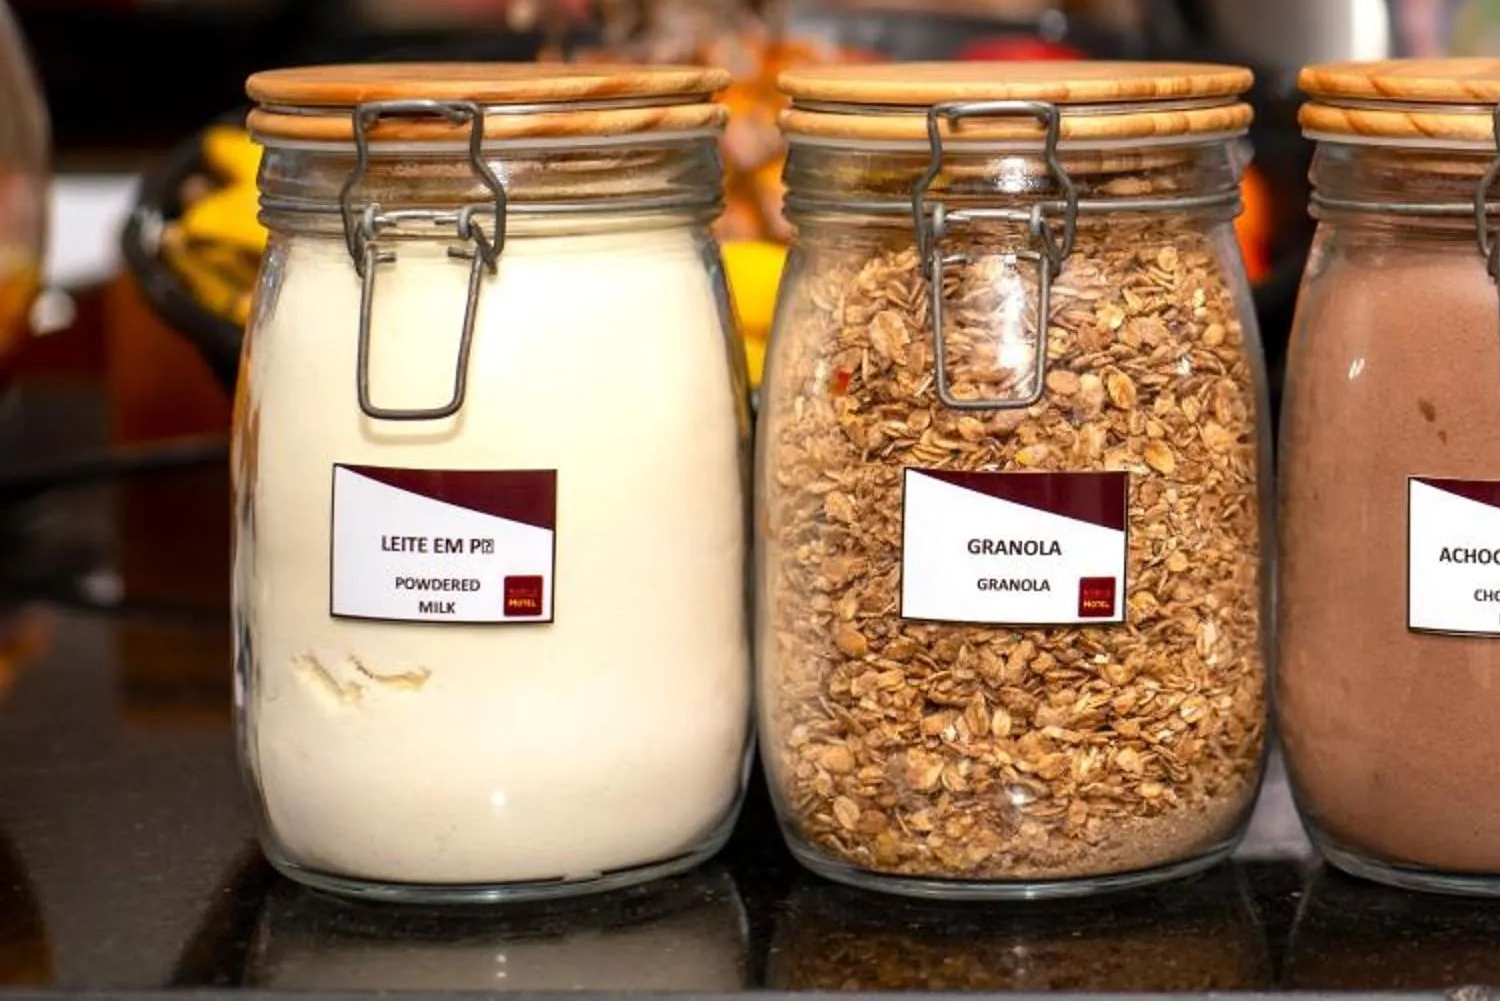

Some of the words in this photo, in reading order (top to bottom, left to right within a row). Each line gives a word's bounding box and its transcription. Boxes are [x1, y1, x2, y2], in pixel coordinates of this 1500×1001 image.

[382, 535, 427, 553] LEITE
[434, 538, 463, 553] EM
[968, 539, 1062, 556] GRANOLA
[396, 577, 480, 591] POWDERED
[977, 579, 1050, 591] GRANOLA
[419, 601, 455, 613] MILK
